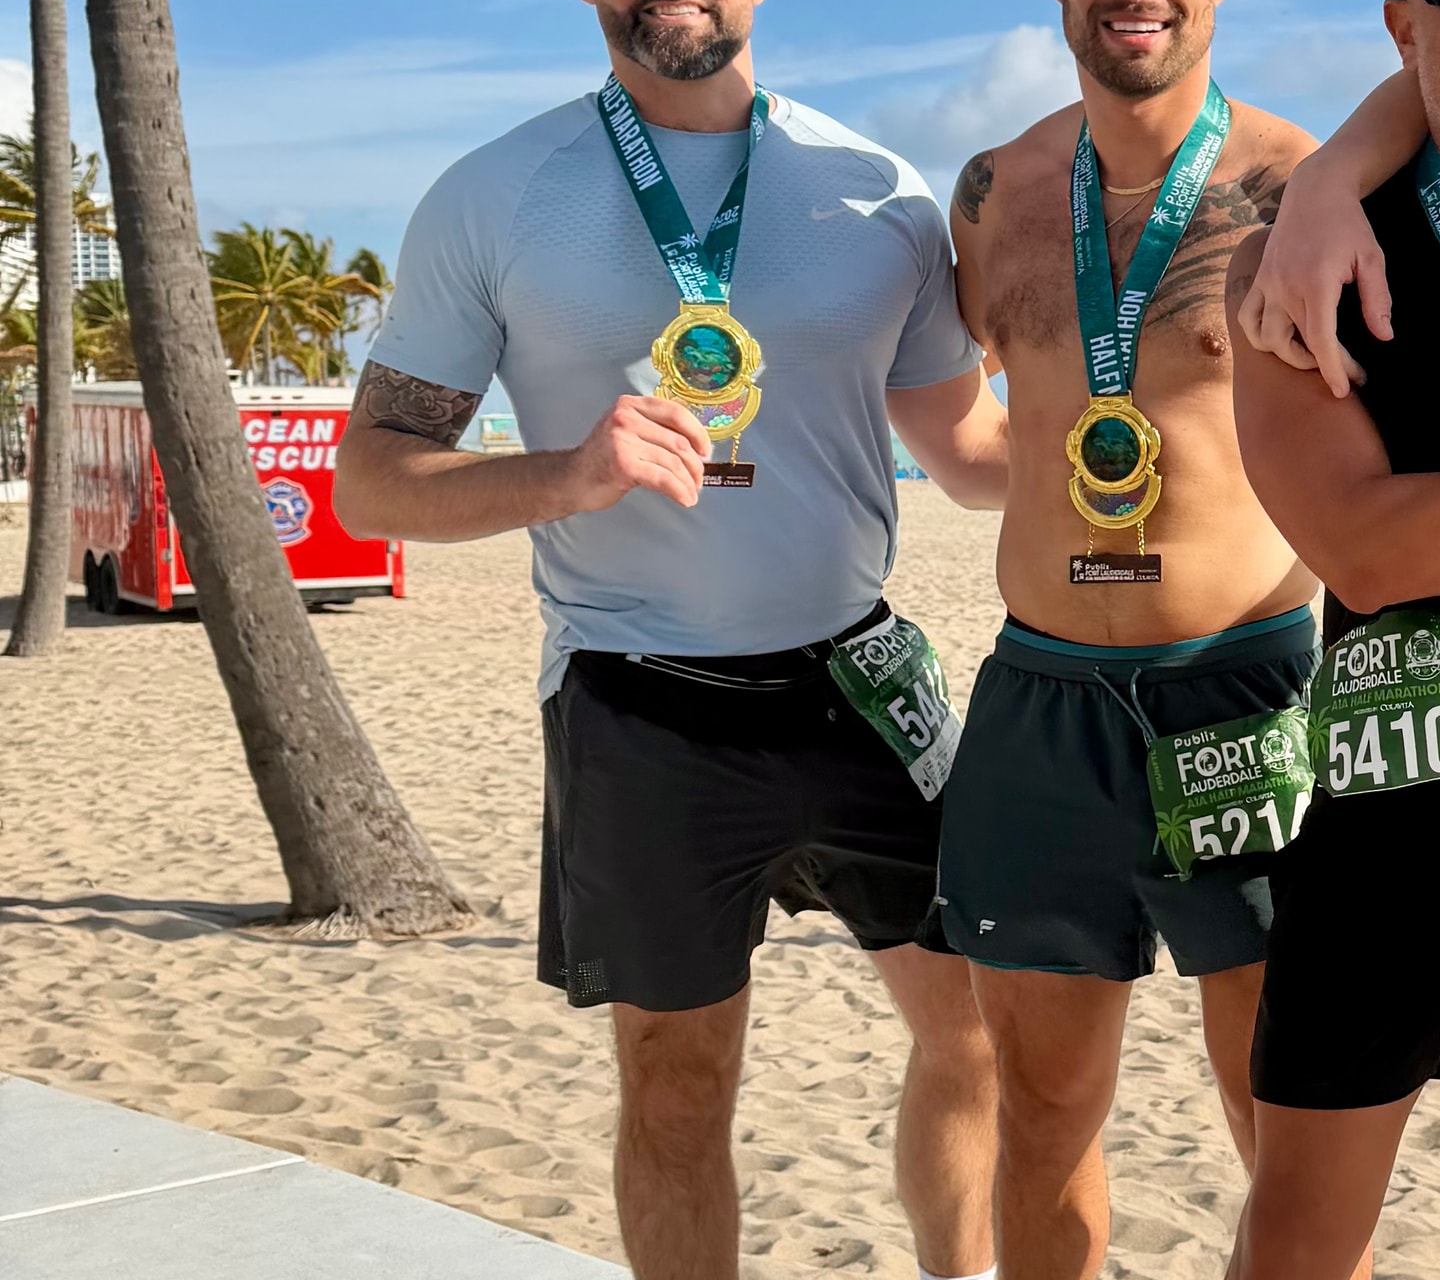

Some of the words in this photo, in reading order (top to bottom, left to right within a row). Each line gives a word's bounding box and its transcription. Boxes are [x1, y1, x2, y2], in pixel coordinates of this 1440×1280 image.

[609, 102, 663, 191] MARATHON
[1090, 333, 1120, 383] HALF
[244, 418, 336, 443] CEAN
[1333, 633, 1402, 682] FORT
[1332, 669, 1403, 697] LAUDERDALE
[1350, 693, 1373, 708] HALF
[1174, 730, 1217, 750] Publix
[1176, 735, 1258, 782] FORT
[1182, 765, 1263, 797] LAUDERDALE
[1209, 787, 1236, 804] HALF
